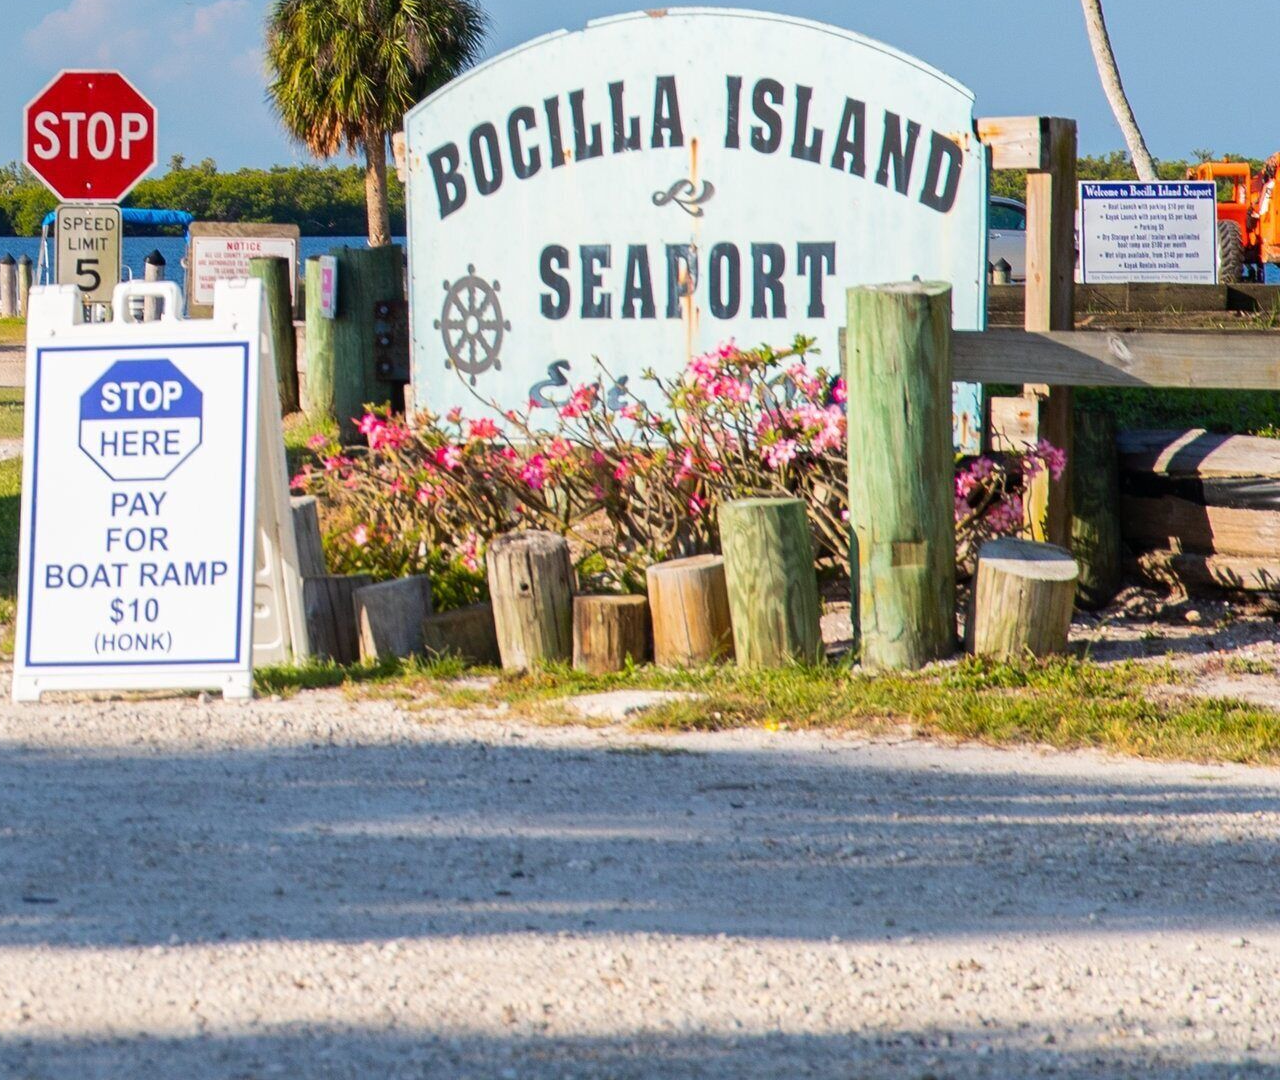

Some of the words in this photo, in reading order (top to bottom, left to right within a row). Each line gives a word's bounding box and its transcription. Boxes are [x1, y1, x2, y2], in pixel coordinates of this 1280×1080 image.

[33, 110, 149, 160] STOP
[426, 74, 684, 220] BOCILLA
[725, 75, 964, 214] ISLAND
[1085, 185, 1119, 197] Welcome
[1120, 188, 1128, 196] to
[1129, 185, 1156, 196] Bocilla
[1158, 185, 1180, 196] Island
[1183, 185, 1212, 199] Seaport
[63, 217, 115, 231] SPEED
[68, 237, 108, 251] LIMIT
[226, 242, 262, 251] NOTICE
[76, 259, 101, 292] 5
[539, 241, 836, 319] SEAPORT
[100, 379, 182, 413] STOP
[100, 430, 180, 456] HERE
[111, 491, 168, 517] PAY
[106, 527, 169, 552] FOR
[45, 563, 129, 589] BOAT
[139, 561, 228, 586] RAMP
[110, 598, 159, 624] $10
[94, 631, 172, 653] (HONK)
